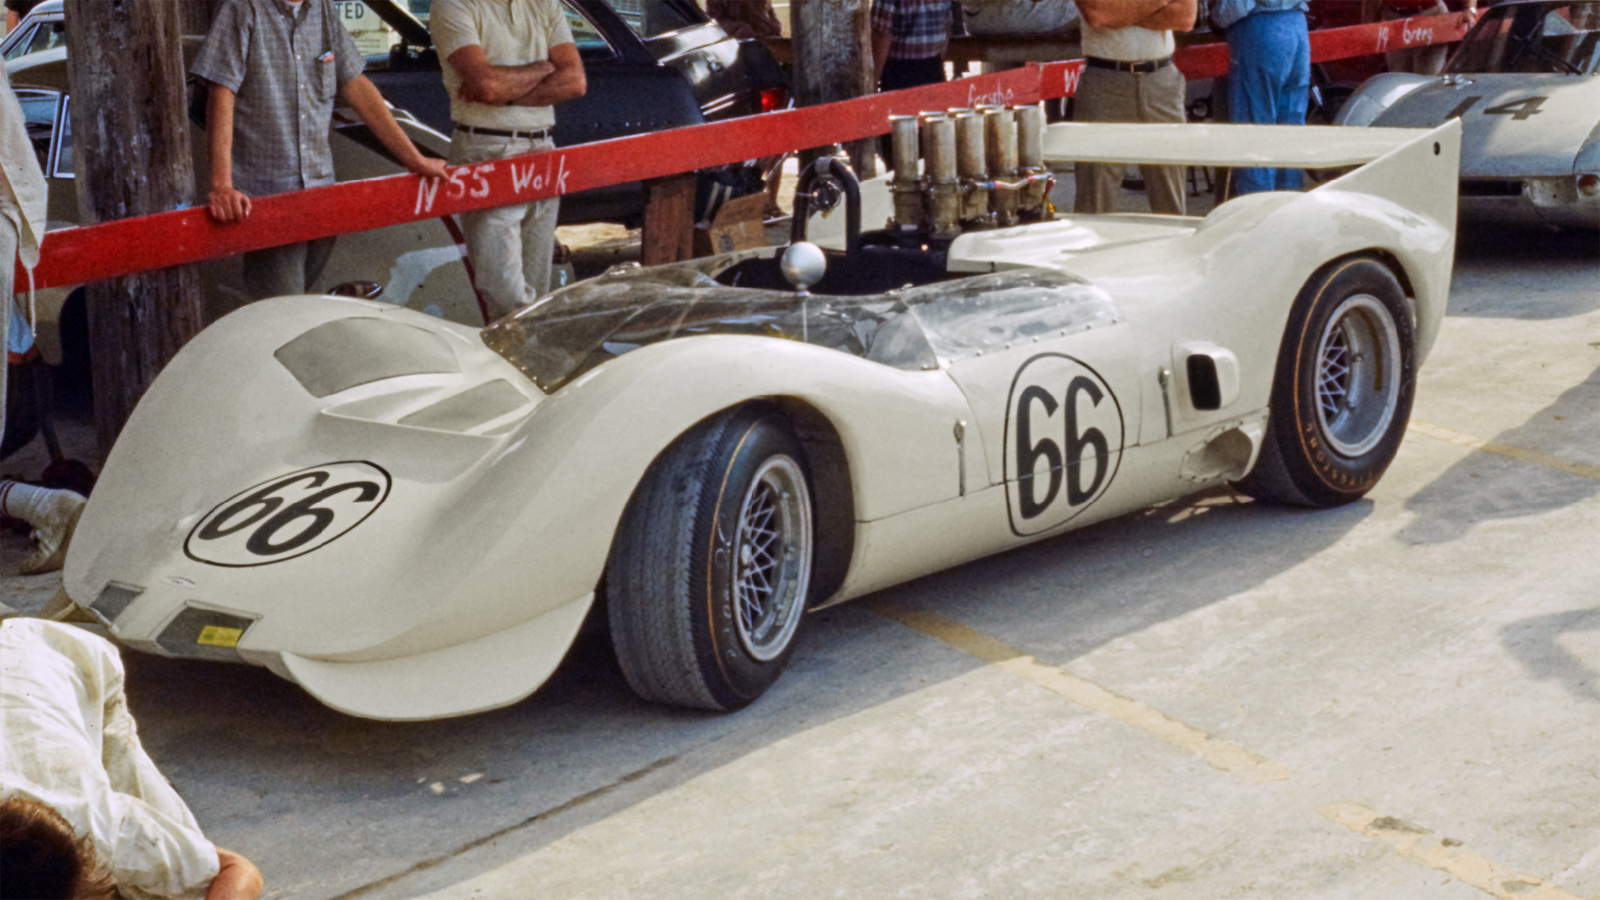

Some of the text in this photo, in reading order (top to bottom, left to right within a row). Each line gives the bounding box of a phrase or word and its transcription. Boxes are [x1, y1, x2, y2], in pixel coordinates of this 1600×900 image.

[1445, 96, 1549, 120] 14
[1016, 375, 1110, 520] 66
[197, 470, 380, 556] 66
